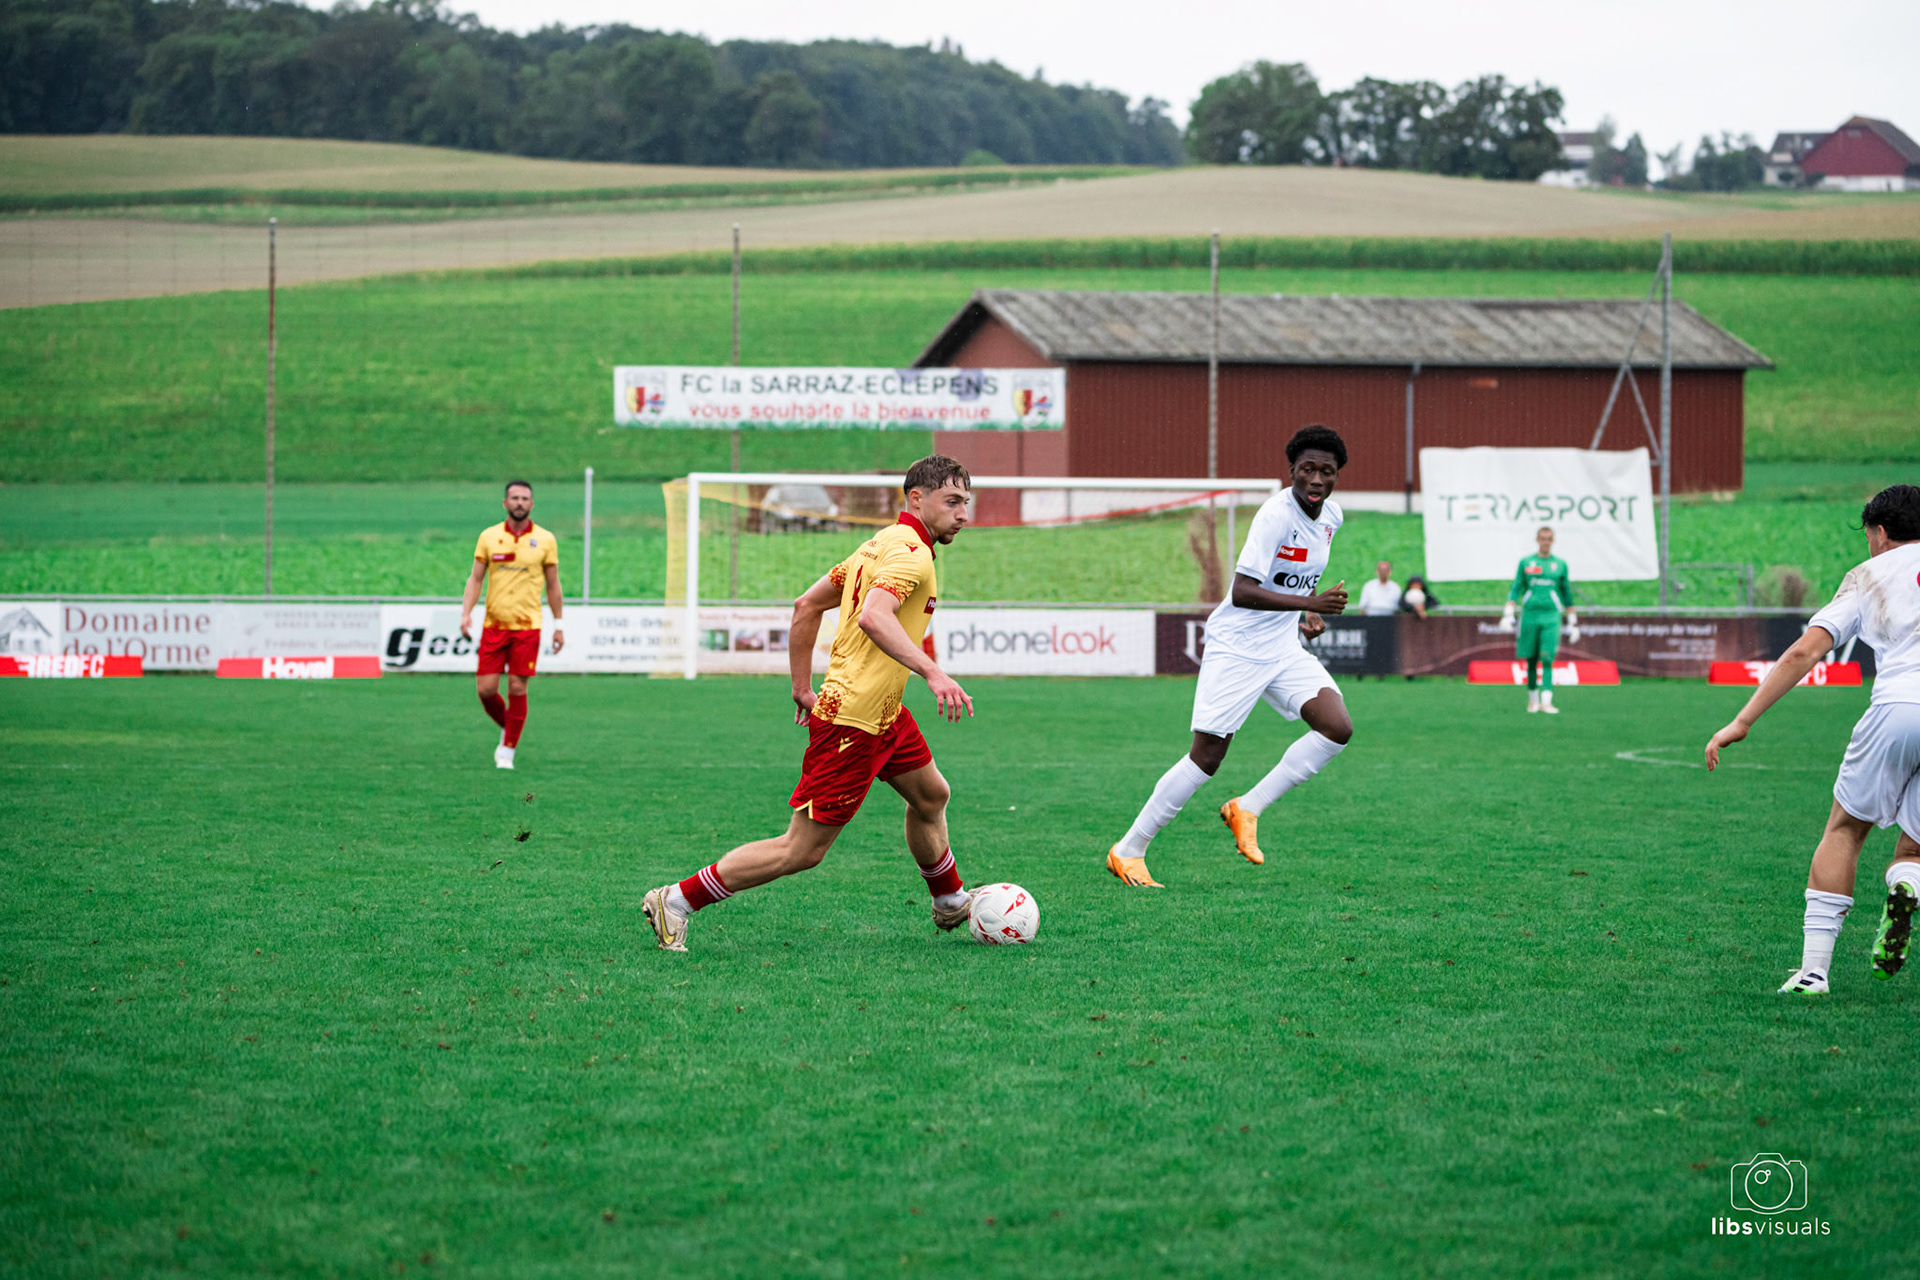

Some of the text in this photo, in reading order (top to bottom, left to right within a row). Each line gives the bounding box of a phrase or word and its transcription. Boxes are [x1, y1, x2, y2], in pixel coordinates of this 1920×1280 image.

[681, 374, 998, 396] FC la SARRAZ-ECLEPENS
[690, 401, 991, 420] vous souhaite la bienvenue
[1439, 494, 1638, 521] TERRASPORT
[65, 607, 210, 633] Domaine
[949, 625, 1116, 659] phonelook
